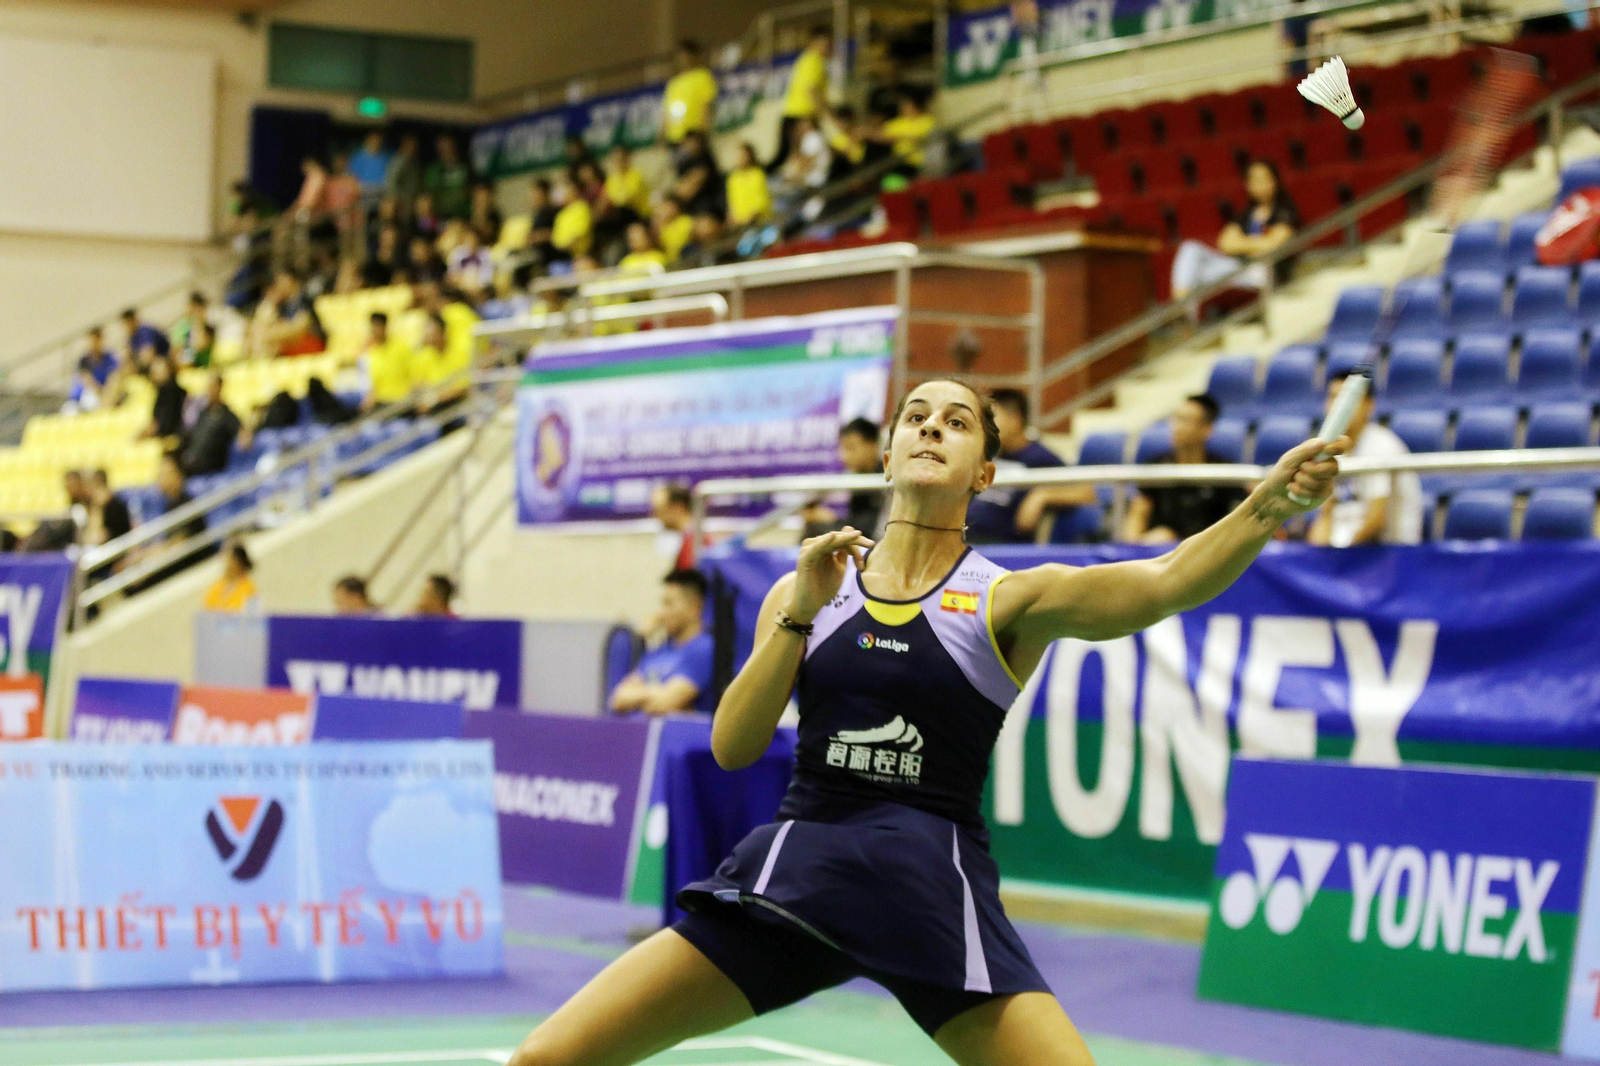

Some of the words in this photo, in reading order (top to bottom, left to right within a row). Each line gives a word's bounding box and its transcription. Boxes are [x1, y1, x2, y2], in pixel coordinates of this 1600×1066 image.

[875, 637, 909, 652] LaLiga
[993, 611, 1439, 846] YONEX
[16, 889, 176, 950] THIẾT
[193, 903, 243, 961] BỊ
[257, 901, 288, 948] Y
[301, 884, 366, 948] TẾ
[377, 899, 408, 945] Y
[419, 887, 483, 944] VŨ
[1348, 843, 1560, 963] YONEX
